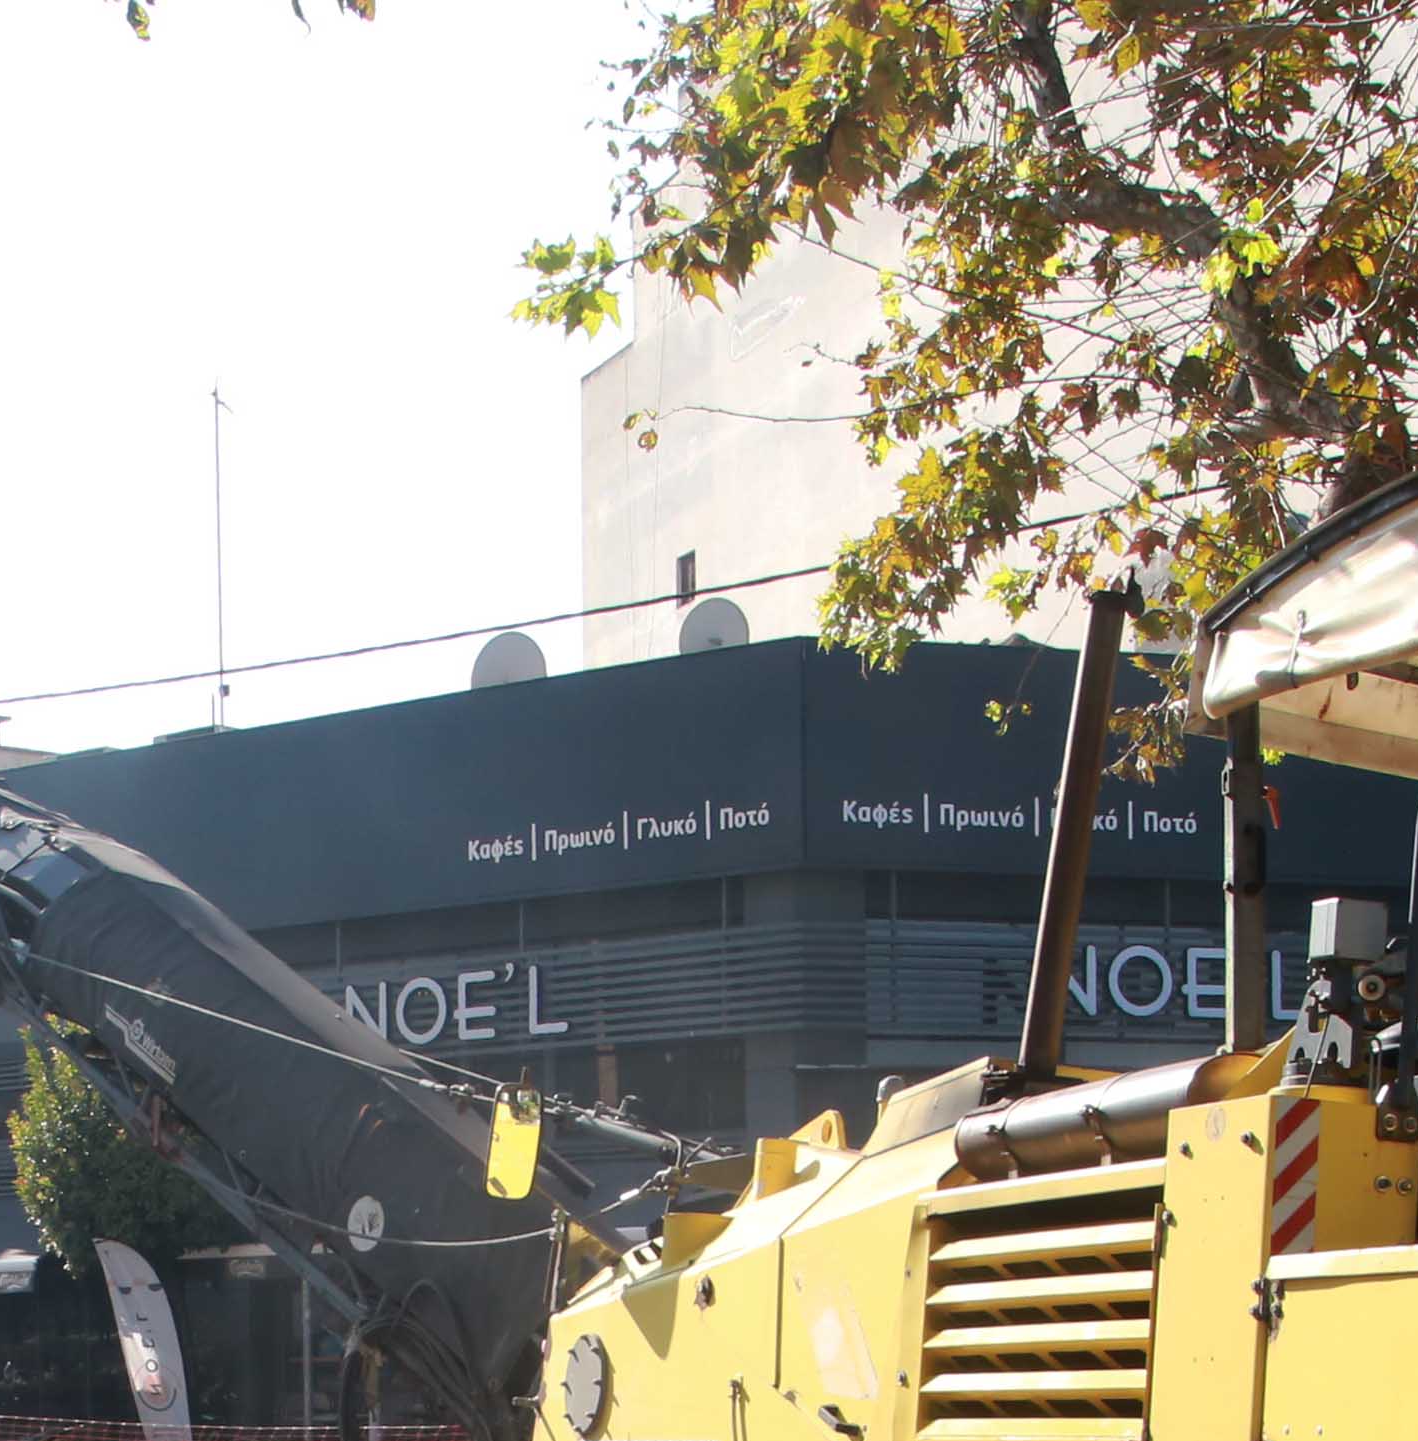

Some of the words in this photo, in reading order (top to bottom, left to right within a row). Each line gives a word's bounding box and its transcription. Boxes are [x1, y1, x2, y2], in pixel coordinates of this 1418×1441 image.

[468, 835, 524, 863] Καφές
[544, 822, 616, 855] Πρωινό
[636, 812, 698, 840] Γλυκό
[719, 802, 770, 830] Ποτό
[842, 799, 914, 829] Καφές
[939, 803, 1025, 831] Πρωινό
[1143, 810, 1198, 835] Ποτό
[1068, 945, 1301, 1021] NOEL
